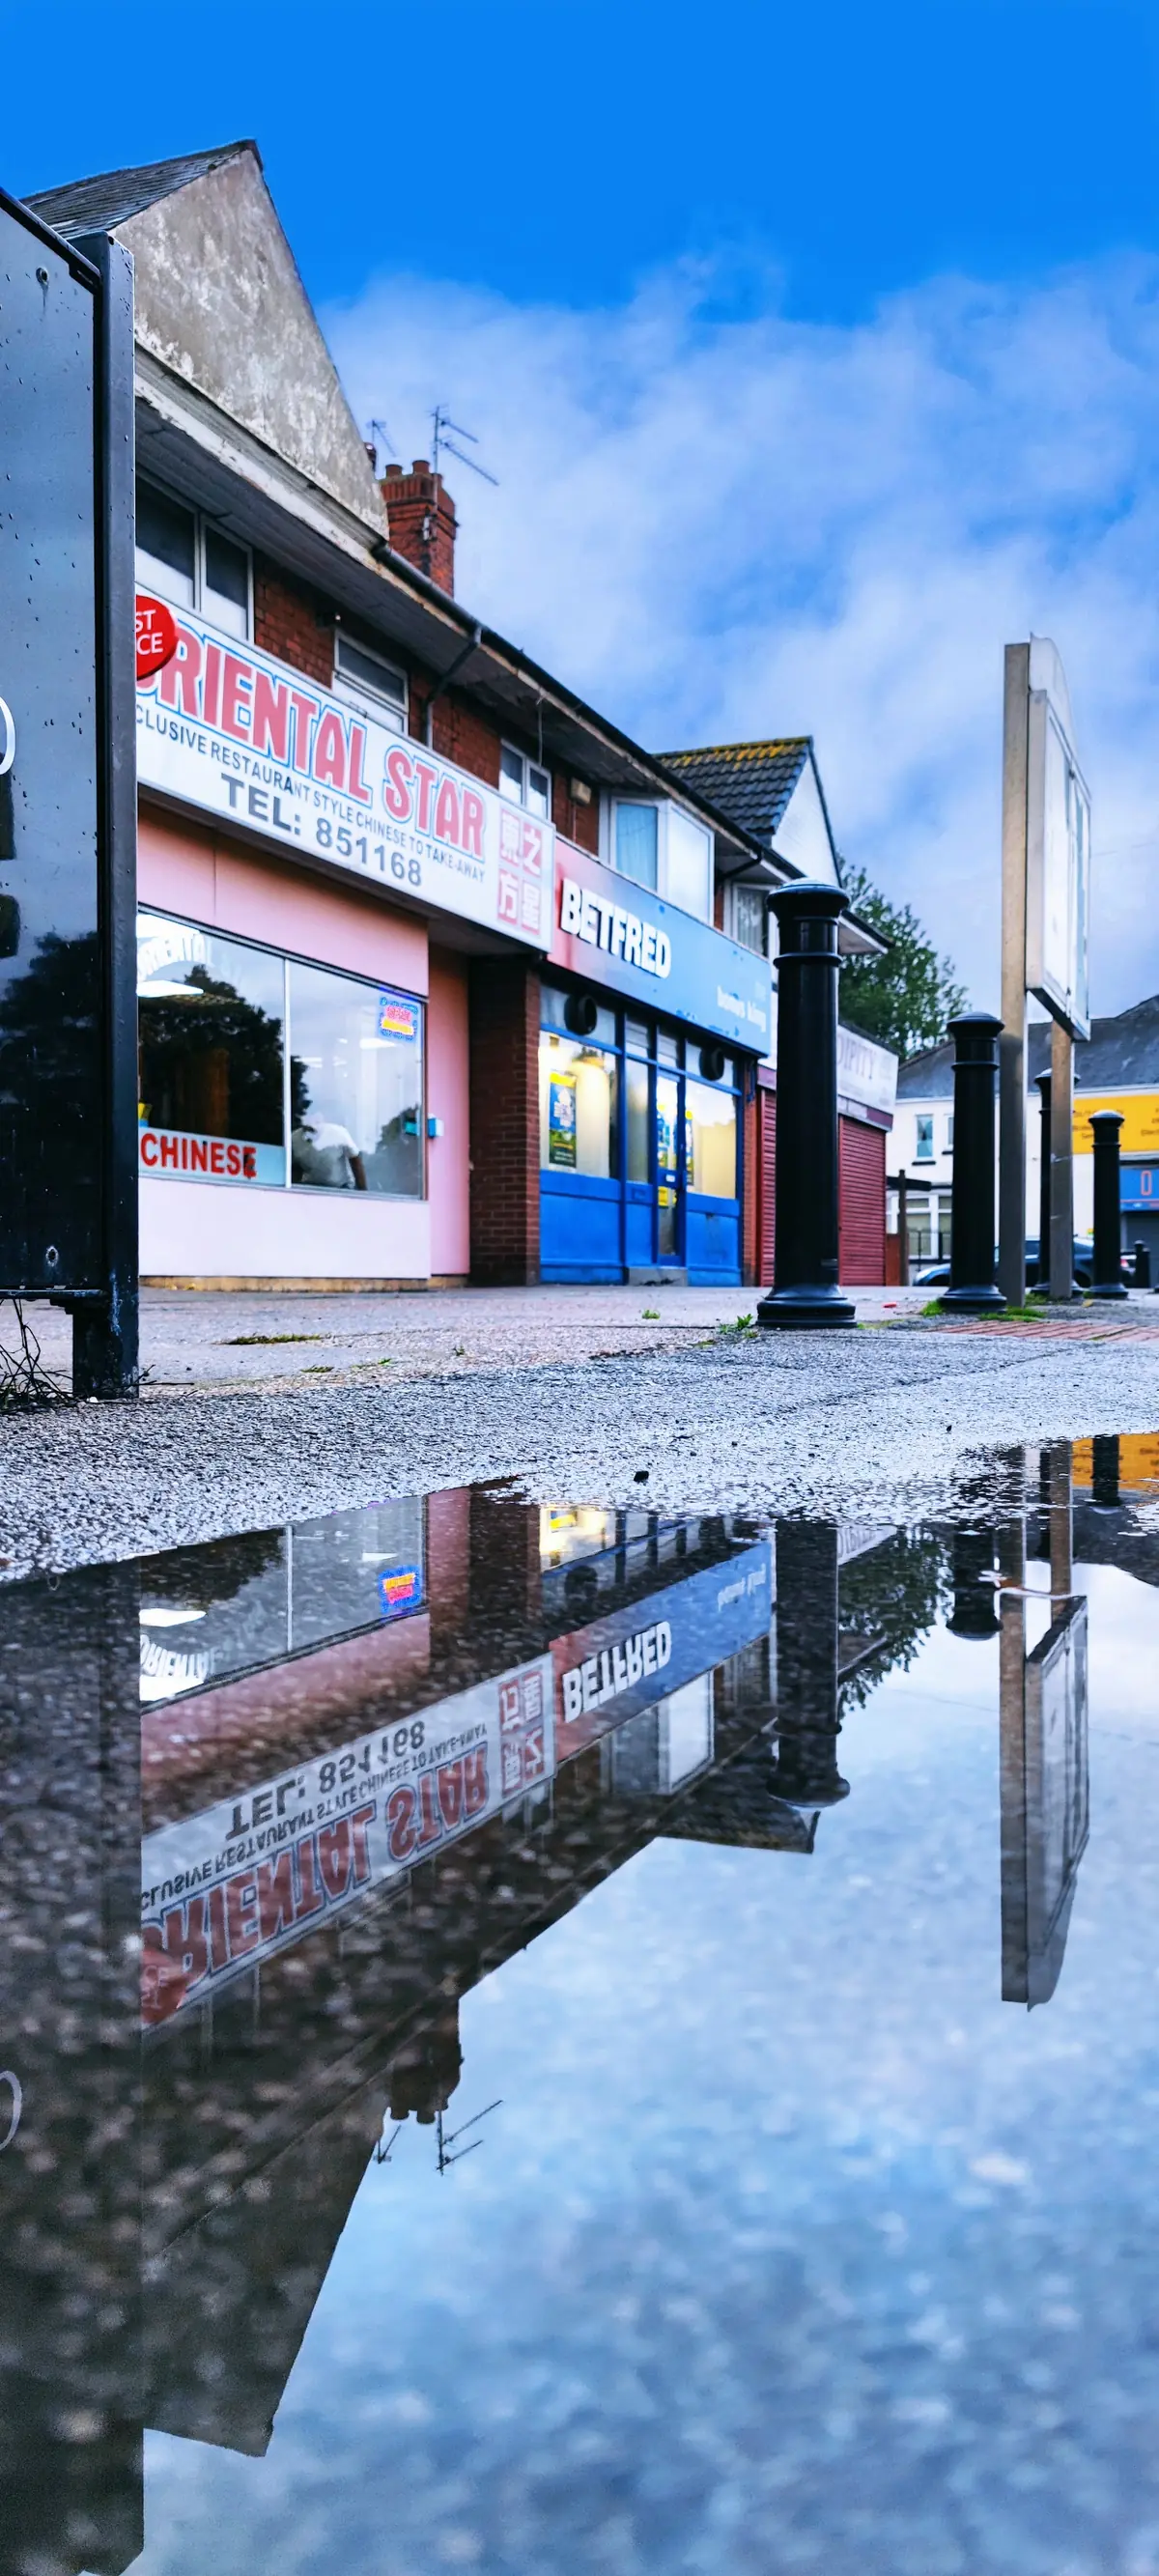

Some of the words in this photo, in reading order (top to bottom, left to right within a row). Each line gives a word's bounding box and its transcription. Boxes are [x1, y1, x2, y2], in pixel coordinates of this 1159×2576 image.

[136, 619, 373, 809] RIENTAL
[382, 746, 486, 864] STAR
[211, 741, 310, 803] RESTAURANT
[314, 791, 354, 824] STYLE
[356, 811, 407, 848] CHINESE
[410, 835, 424, 856] TO
[221, 773, 302, 835] TEL:
[316, 817, 422, 887] 851168
[560, 878, 672, 979] BETFRED
[141, 1133, 257, 1178] CHINESE
